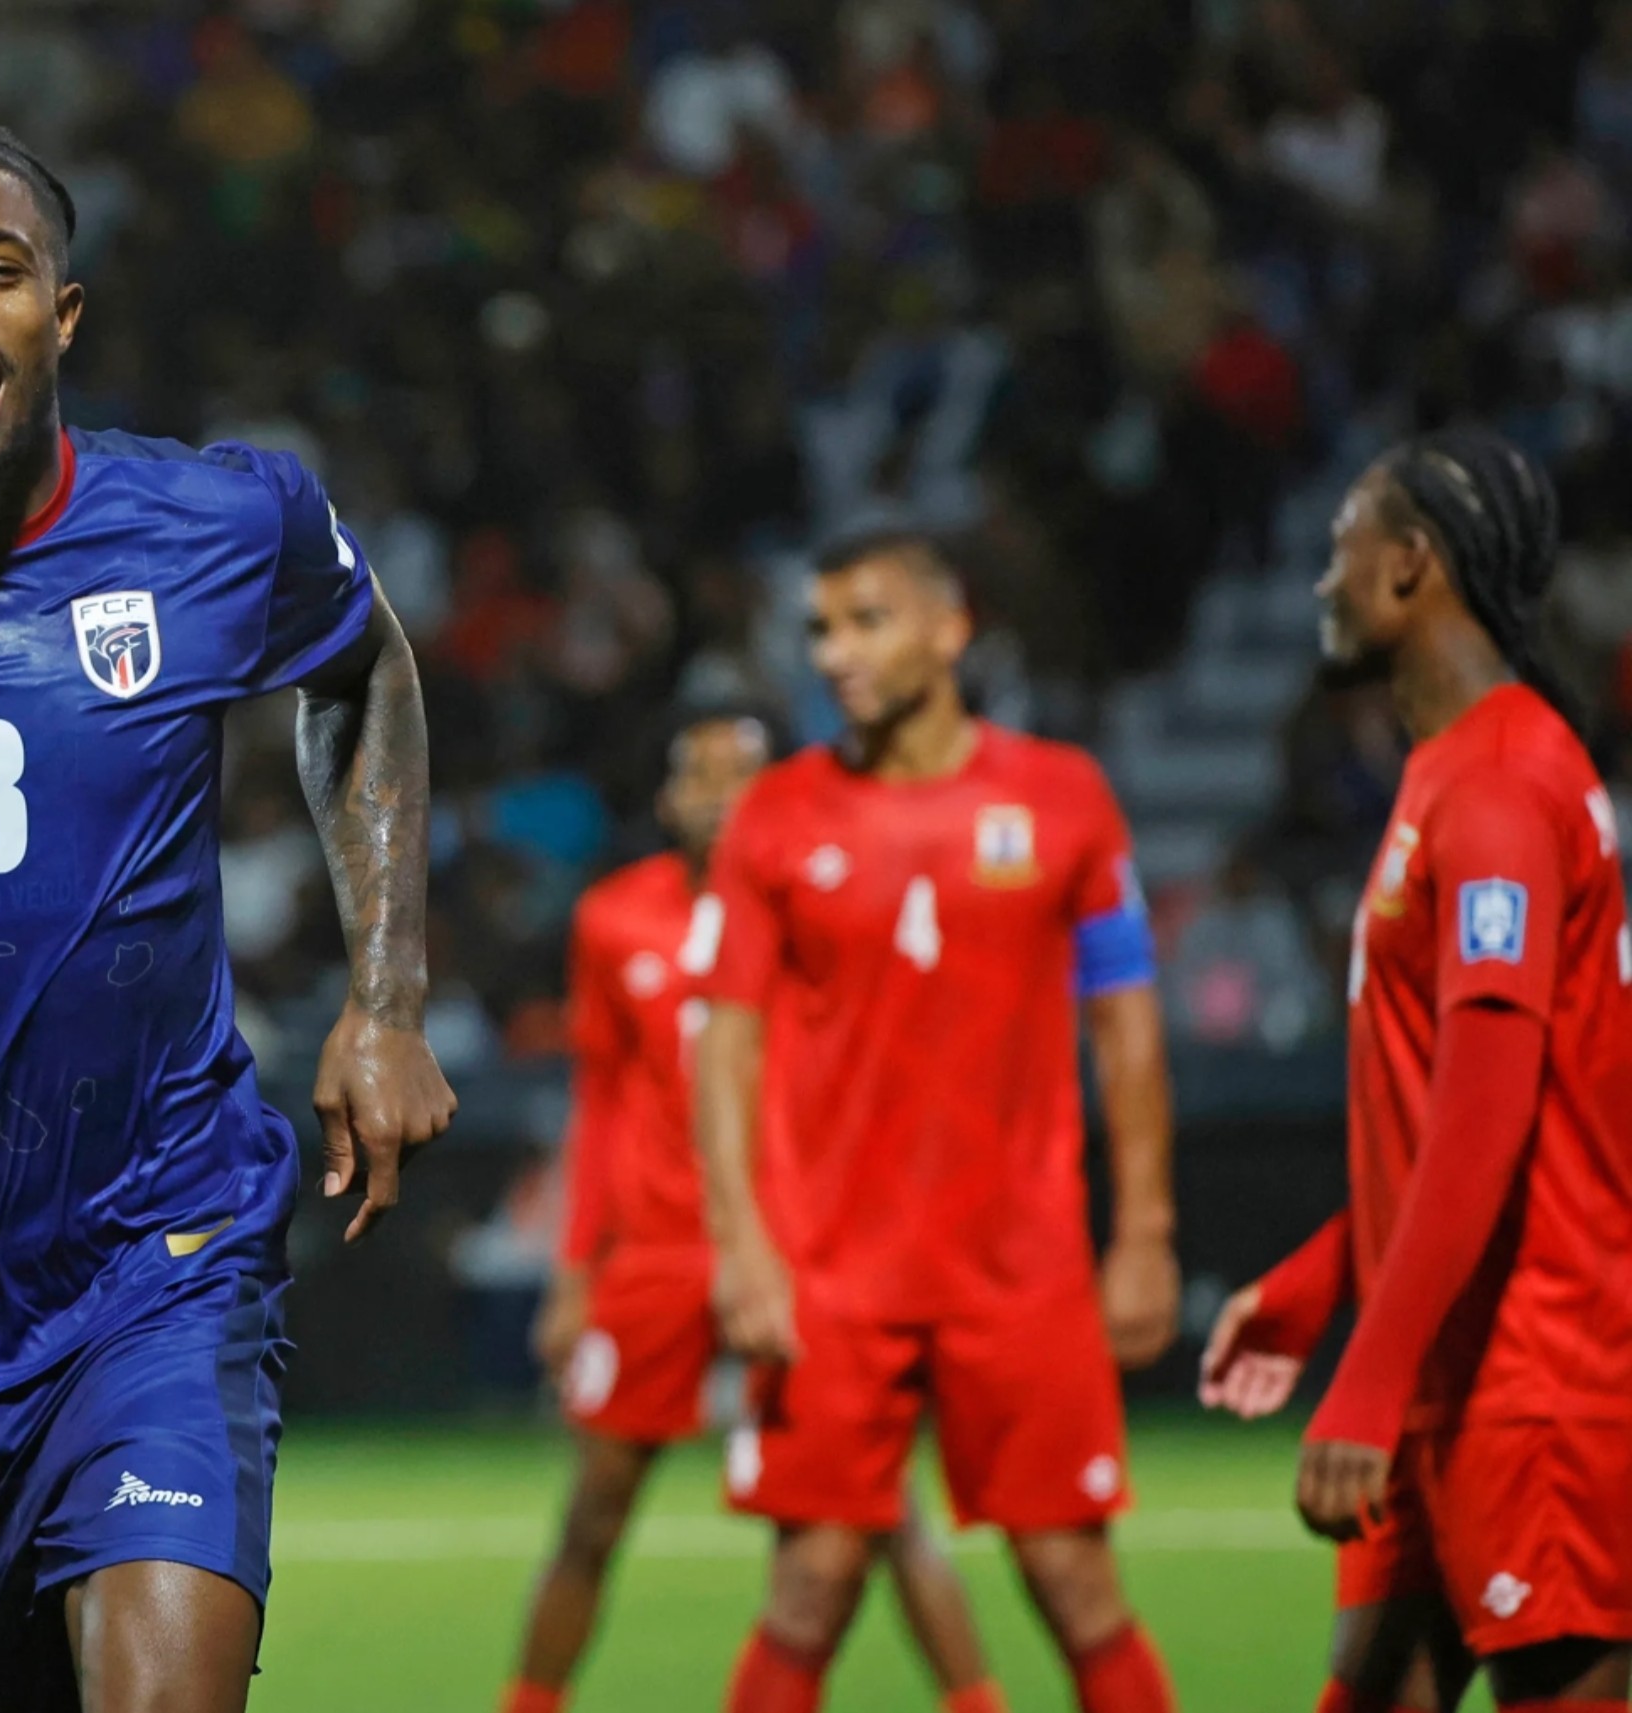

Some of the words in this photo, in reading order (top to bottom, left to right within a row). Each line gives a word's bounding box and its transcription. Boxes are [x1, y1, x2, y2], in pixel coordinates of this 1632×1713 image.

[80, 597, 144, 621] FCF
[893, 873, 944, 974] 4
[129, 1490, 203, 1507] tempo
